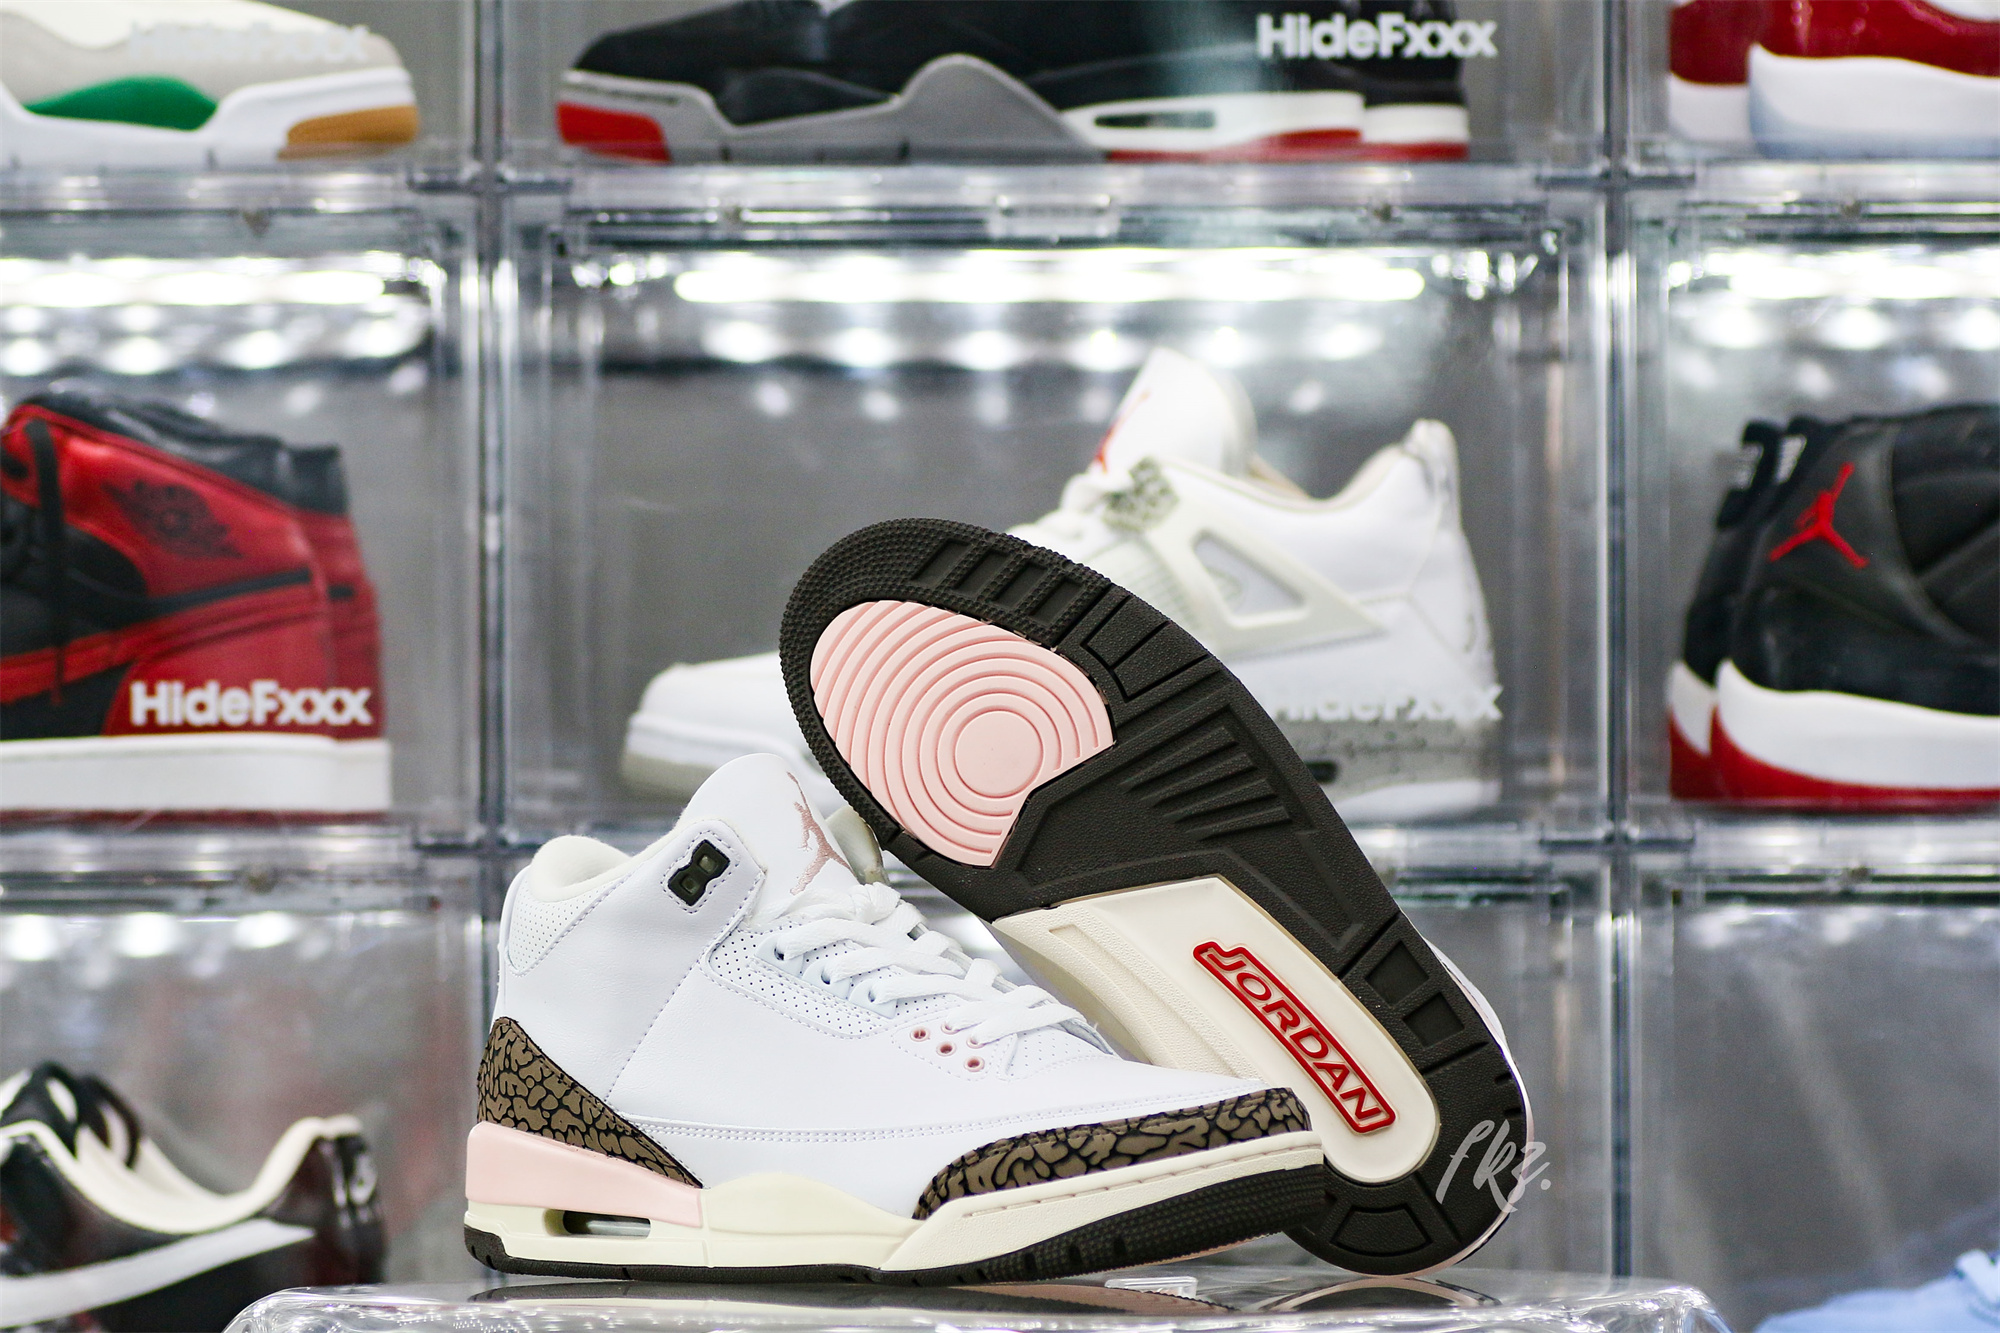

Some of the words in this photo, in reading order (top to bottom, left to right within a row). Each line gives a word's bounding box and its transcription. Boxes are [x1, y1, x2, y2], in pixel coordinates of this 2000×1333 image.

[1257, 12, 1498, 58] HideFxxx
[130, 680, 373, 726] HideFxxx
[1207, 952, 1381, 1120] JORDAN
